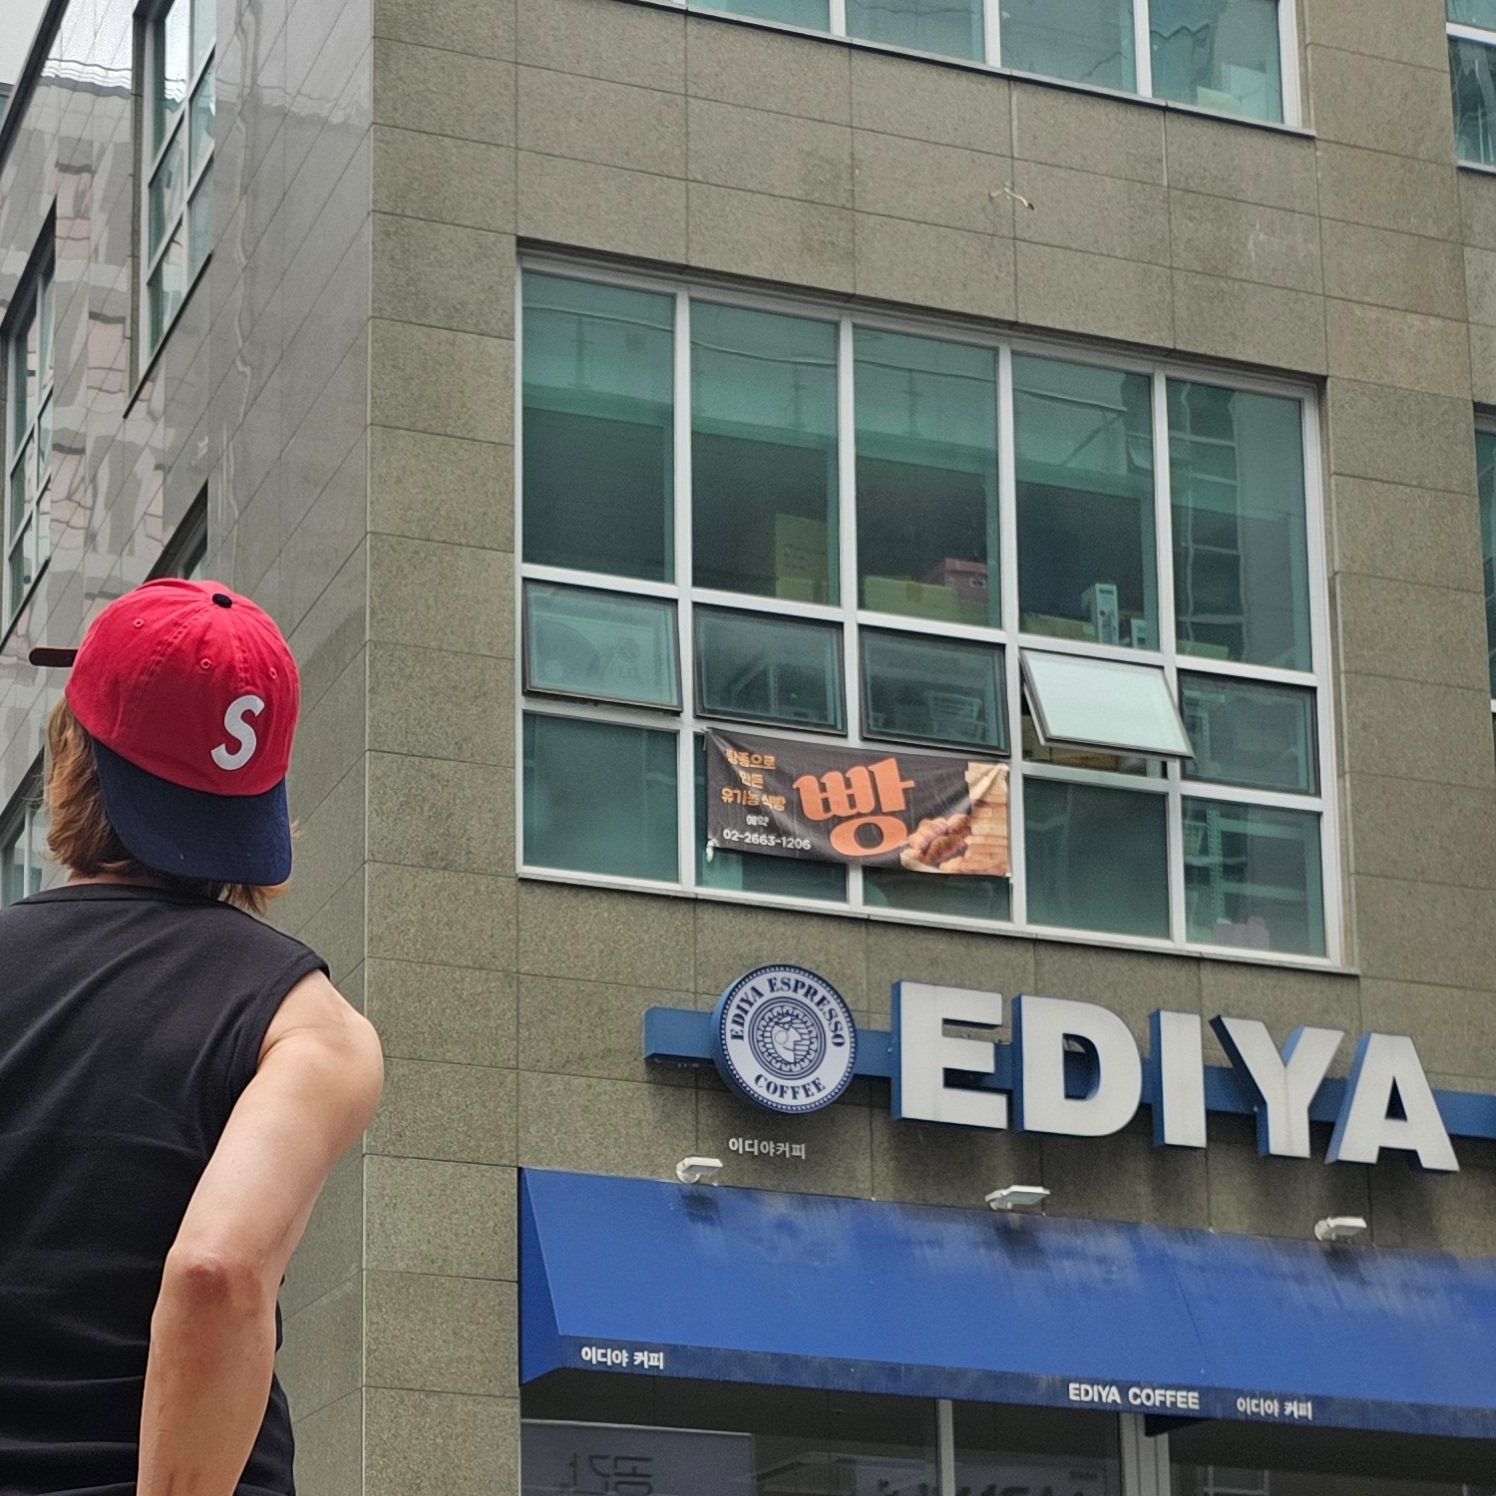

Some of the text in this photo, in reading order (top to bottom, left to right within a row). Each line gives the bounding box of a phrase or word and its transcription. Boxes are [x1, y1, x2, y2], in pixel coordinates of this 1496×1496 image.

[210, 694, 265, 771] S
[721, 786, 760, 806] 유기농
[792, 757, 916, 857] 빵
[722, 828, 812, 850] 02-2663-1206
[730, 975, 846, 1047] EDIYA ESPRESSO
[754, 1073, 827, 1100] COFFEE
[891, 979, 1461, 1172] EDIYA
[728, 1137, 807, 1160] 이디야커피
[580, 1346, 664, 1370] 이디야 커피
[1068, 1382, 1201, 1410] EDIYA COFFEE
[1236, 1396, 1314, 1421] 이디야 커피
